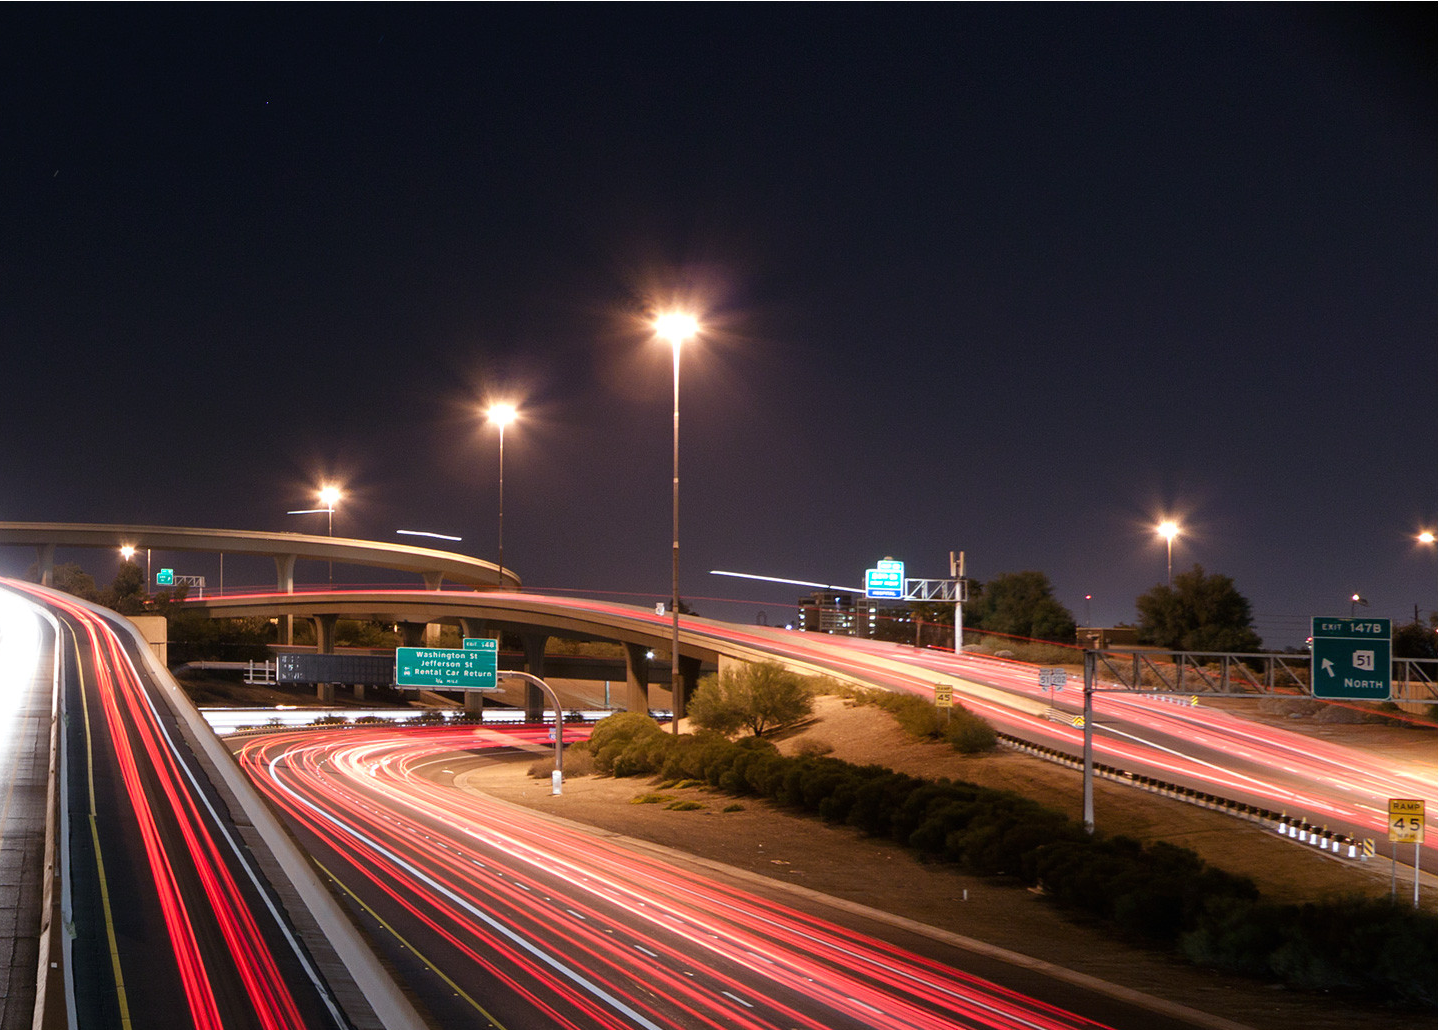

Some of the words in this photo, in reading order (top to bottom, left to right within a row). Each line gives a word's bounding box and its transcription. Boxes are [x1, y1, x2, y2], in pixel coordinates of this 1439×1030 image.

[1350, 623, 1382, 633] 147B
[416, 651, 466, 660] Washington
[1357, 655, 1371, 667] 51
[414, 668, 442, 676] Rental
[1344, 678, 1383, 689] NORTH
[937, 694, 951, 702] 45
[1393, 818, 1420, 831] 45
